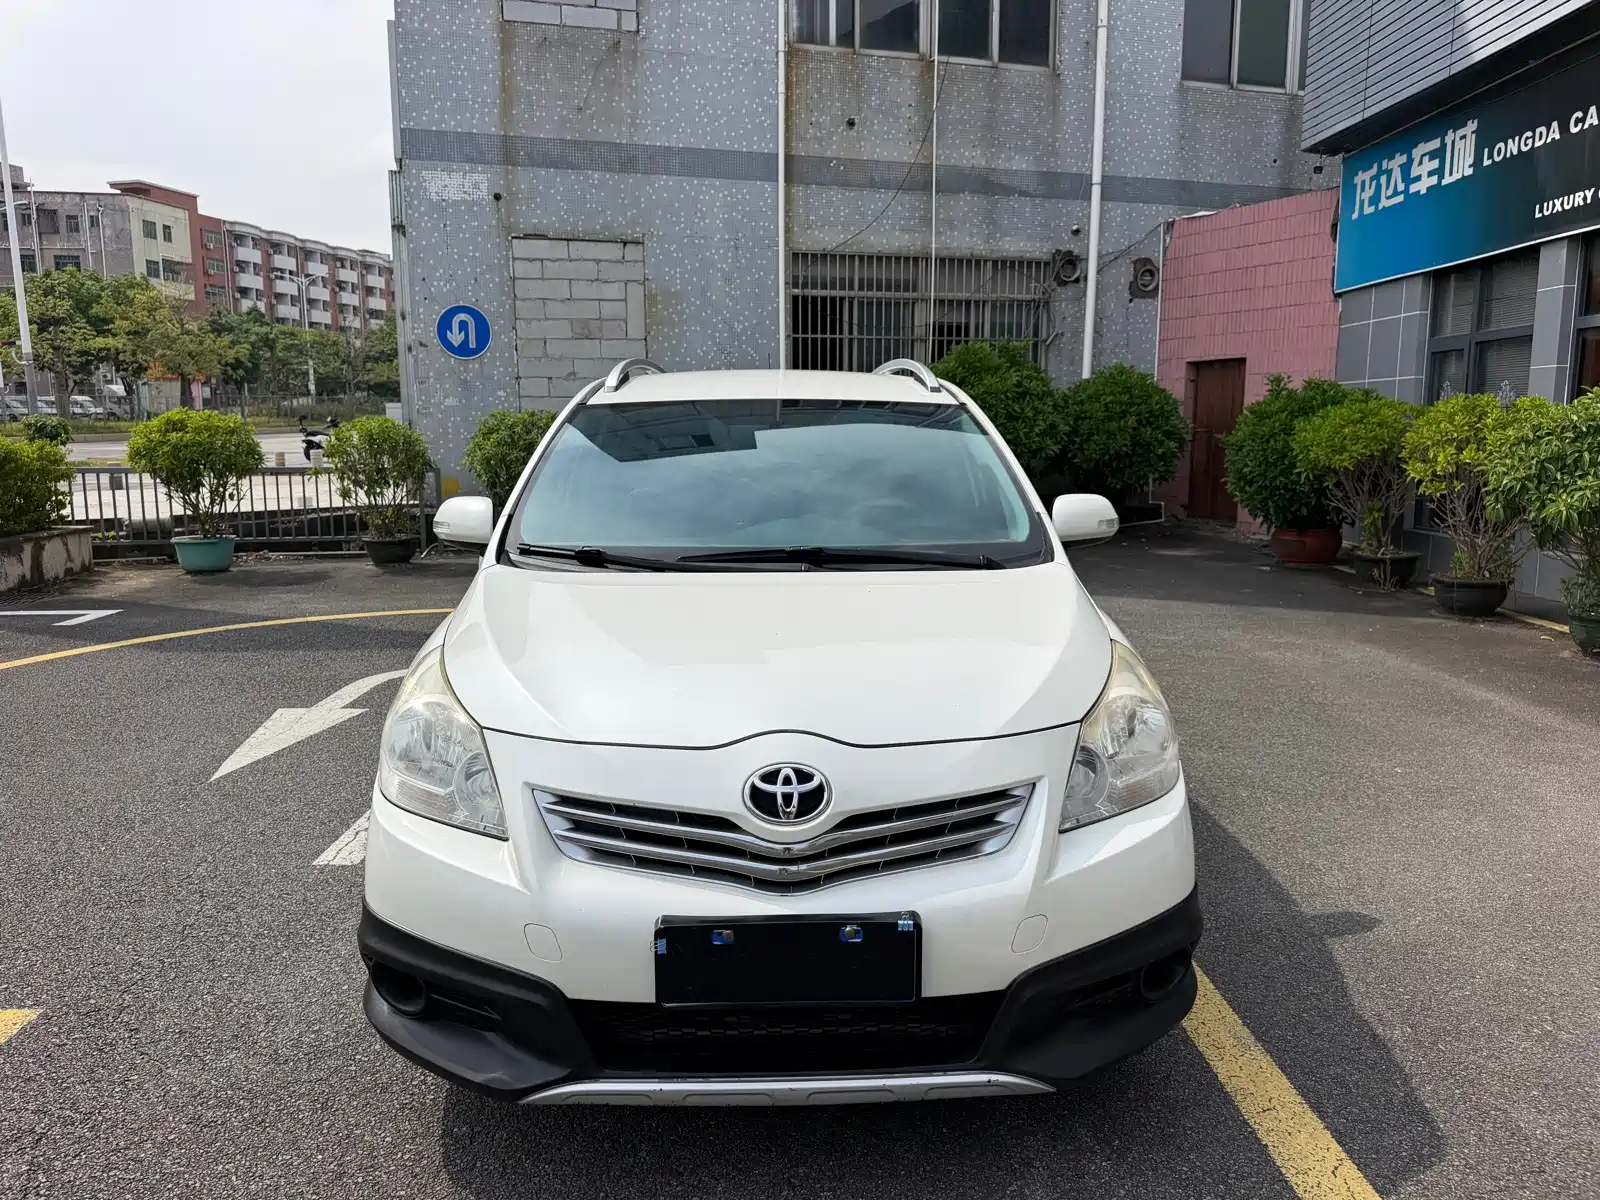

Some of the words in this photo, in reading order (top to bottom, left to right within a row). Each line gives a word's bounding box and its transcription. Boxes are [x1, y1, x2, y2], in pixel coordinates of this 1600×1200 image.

[1482, 120, 1560, 167] LONGDA
[1352, 118, 1479, 220] 龙达车城
[1534, 187, 1596, 219] LUXURY
